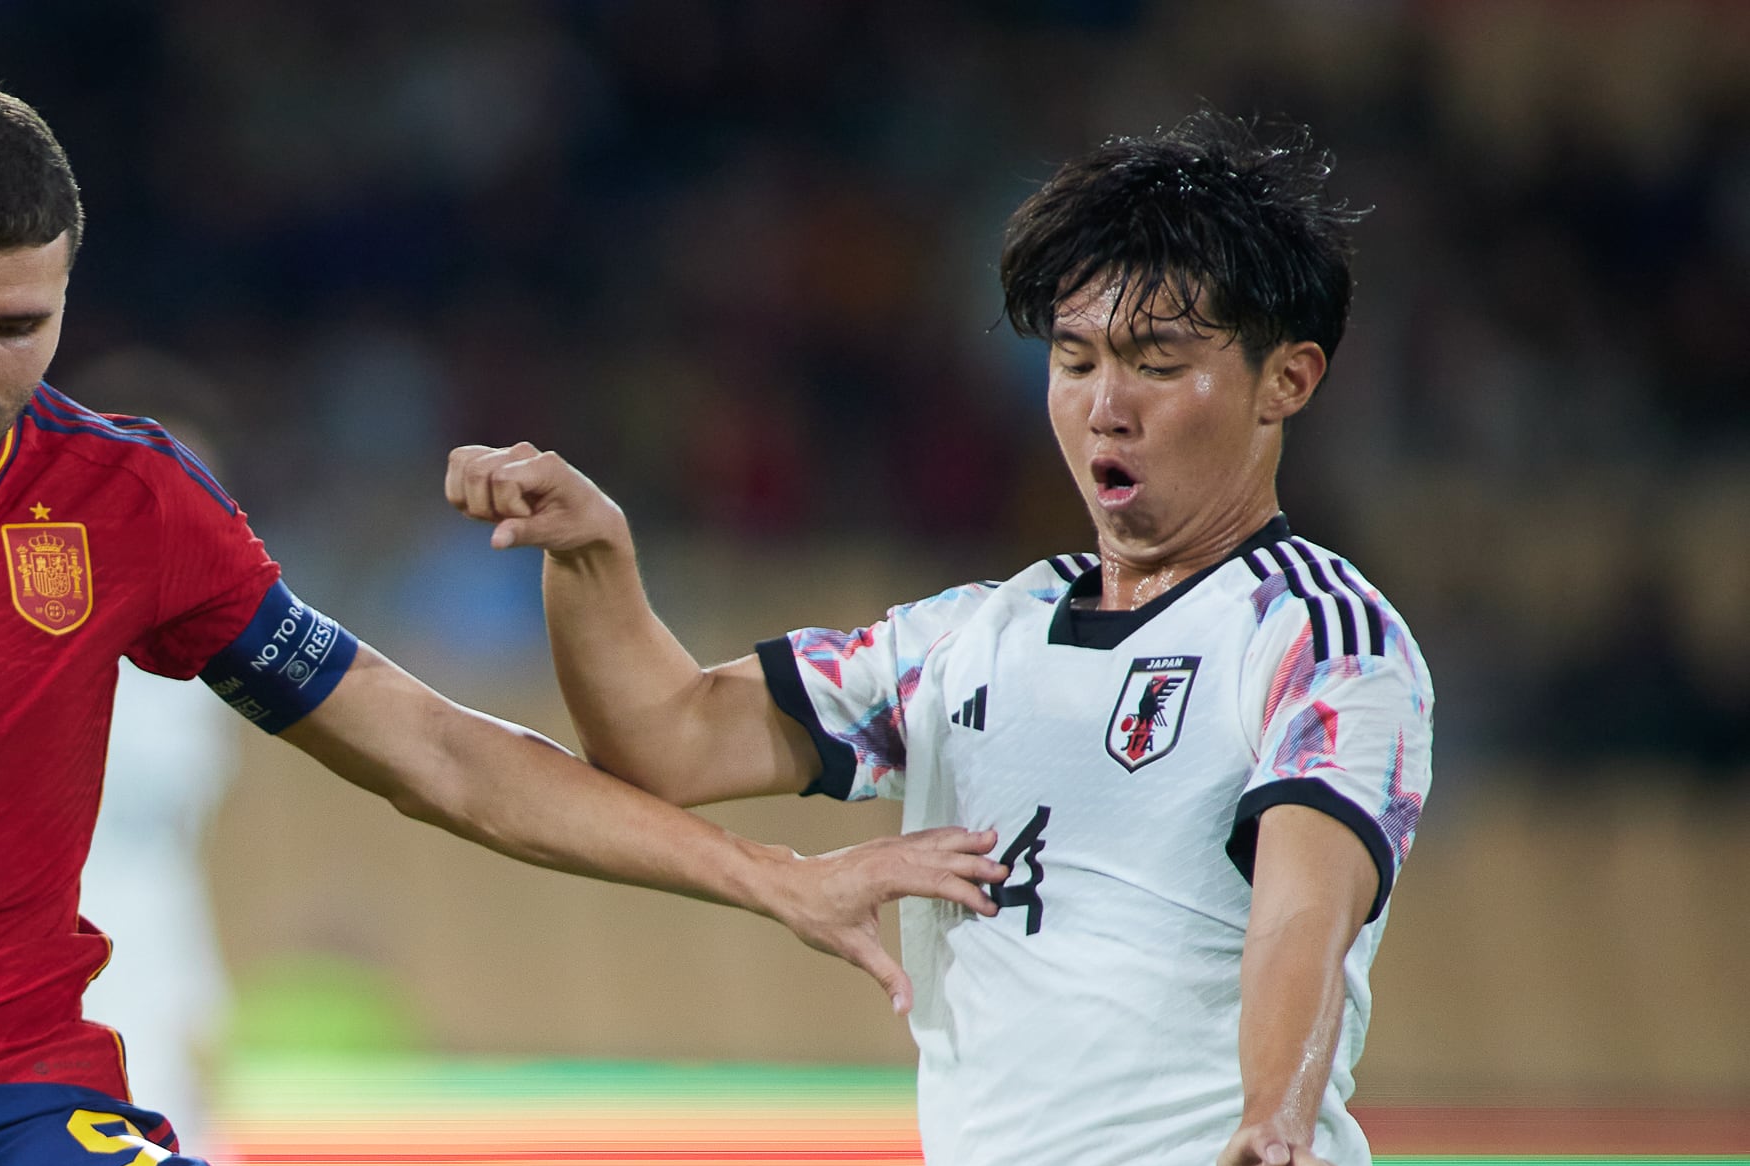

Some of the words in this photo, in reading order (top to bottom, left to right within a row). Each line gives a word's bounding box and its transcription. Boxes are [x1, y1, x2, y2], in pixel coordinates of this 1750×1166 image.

[251, 644, 278, 671] NO
[273, 618, 297, 643] TO
[1146, 658, 1183, 670] JAPAN
[1120, 734, 1154, 752] JFA
[990, 805, 1051, 936] 4
